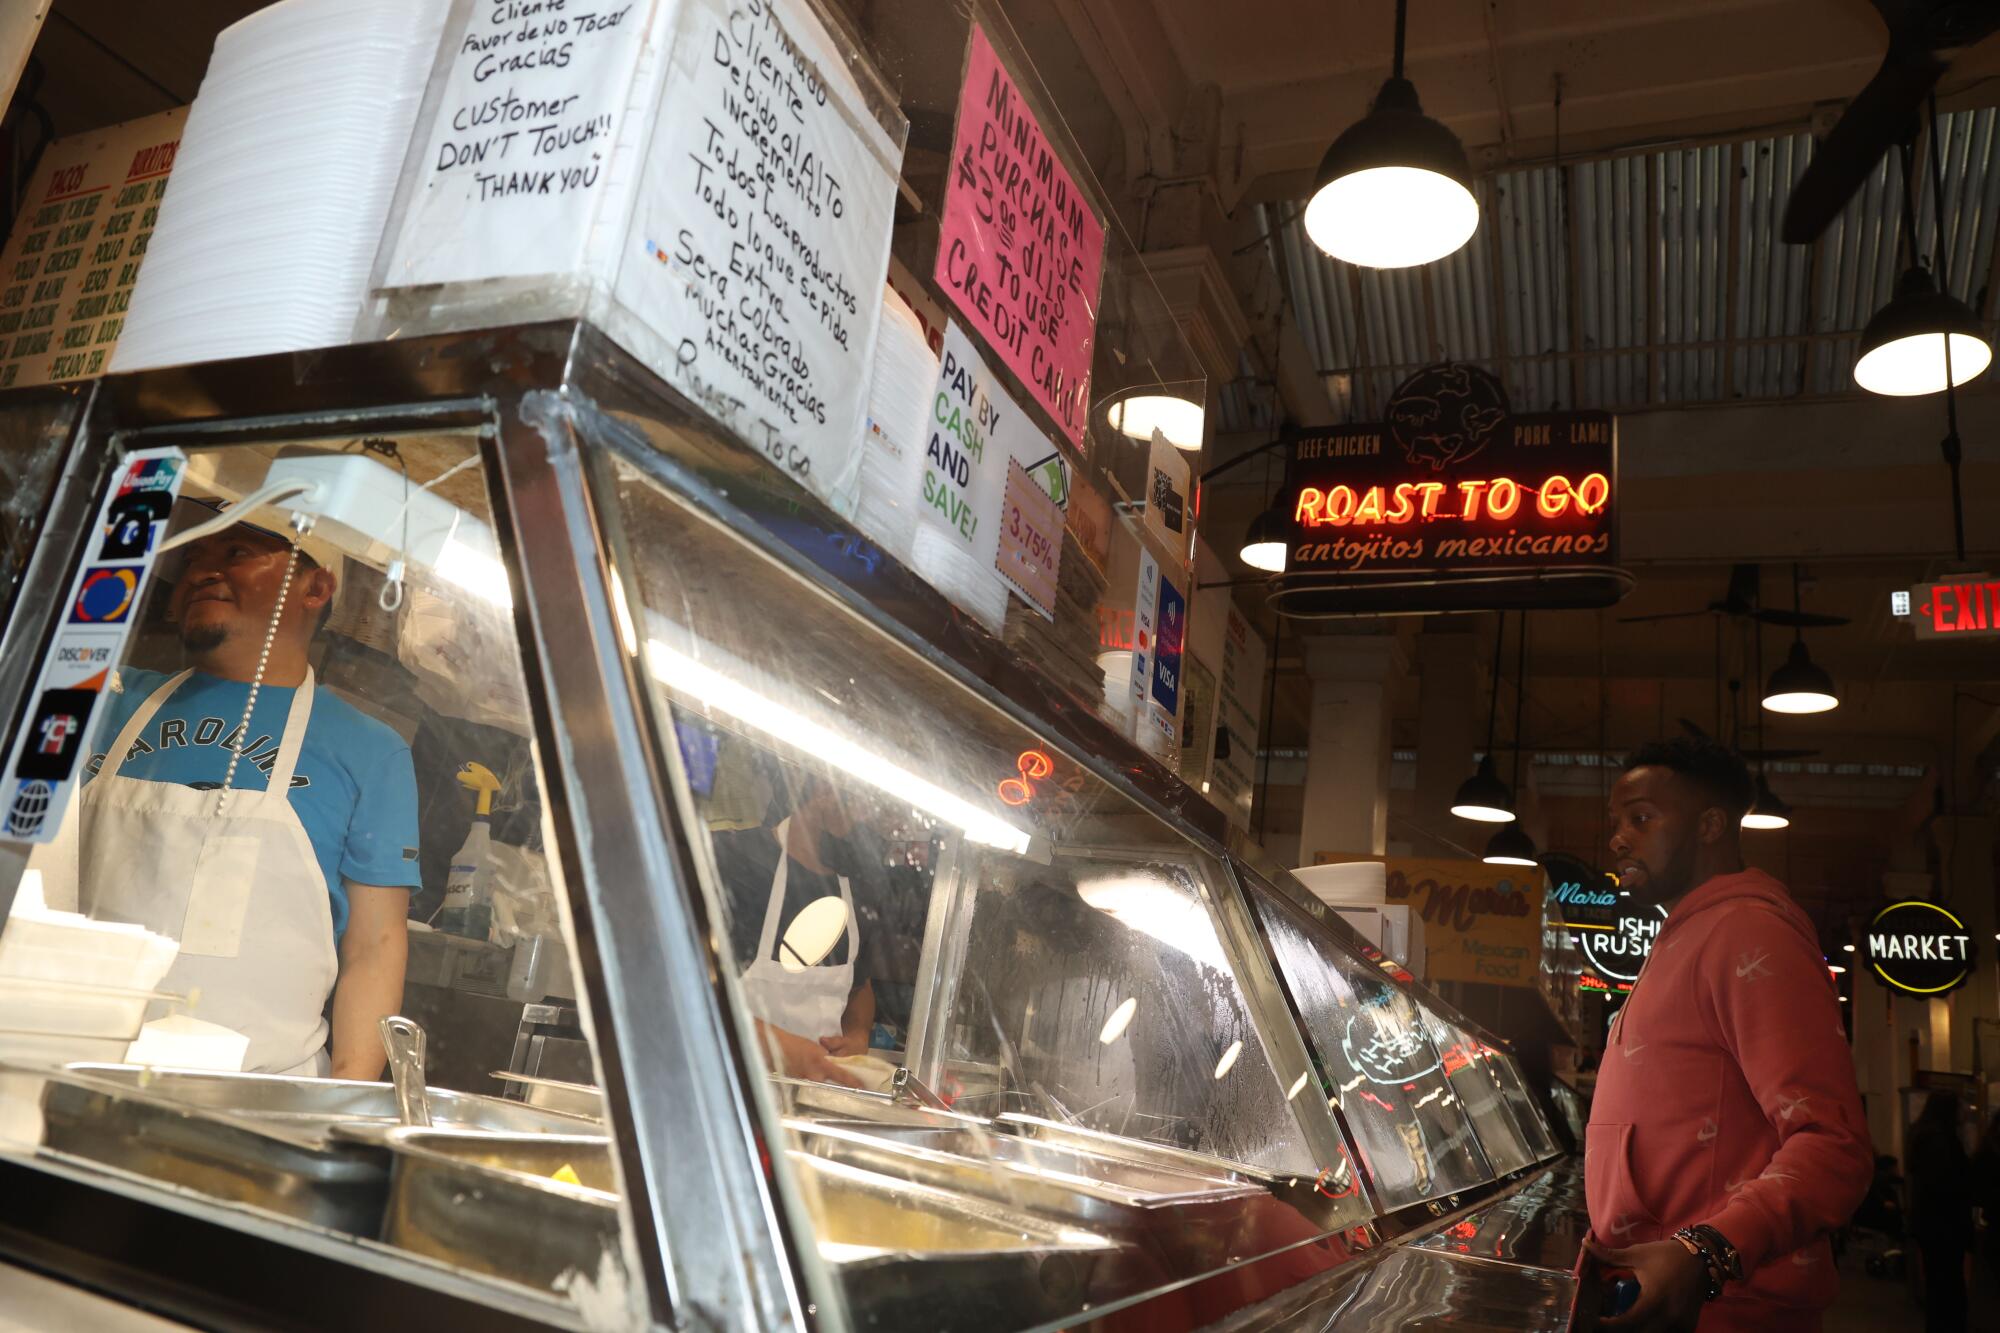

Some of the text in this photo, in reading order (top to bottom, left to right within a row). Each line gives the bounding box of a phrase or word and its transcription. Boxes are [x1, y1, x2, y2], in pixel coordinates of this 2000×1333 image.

[461, 4, 632, 54] Favor de NO Tocar
[492, 0, 565, 24] Cliente
[473, 41, 573, 82] Gracias
[729, 10, 804, 124] Cliente
[714, 30, 777, 135] Debido
[781, 133, 801, 166] al
[50, 163, 89, 197] TACOS
[436, 132, 519, 171] DON'T
[703, 117, 756, 200] Todos
[986, 68, 1084, 250] MiNiMUM
[689, 152, 738, 229] Todo
[979, 121, 1083, 295] PURCHASE
[675, 229, 728, 300] Sera
[729, 241, 790, 324] Extra
[948, 237, 1028, 357] CREDiT
[996, 251, 1059, 347] TO USE
[685, 286, 826, 425] Muchas Gracias
[942, 351, 1000, 436] PAY BY
[935, 391, 984, 464] CASH
[1514, 424, 1550, 447] PORK
[122, 469, 174, 488] UnionPay
[927, 432, 969, 488] AND
[923, 469, 978, 543] SAVE!
[1295, 473, 1609, 527] ROAST TO GO
[1010, 507, 1052, 570] 3.75%
[1294, 529, 1609, 570] antojitos mexicanos
[1932, 584, 2000, 632] EXIT
[57, 647, 110, 663] DISCOVER
[1158, 661, 1175, 692] VISA
[1475, 959, 1520, 978] Food
[1868, 934, 1970, 961] MARKET
